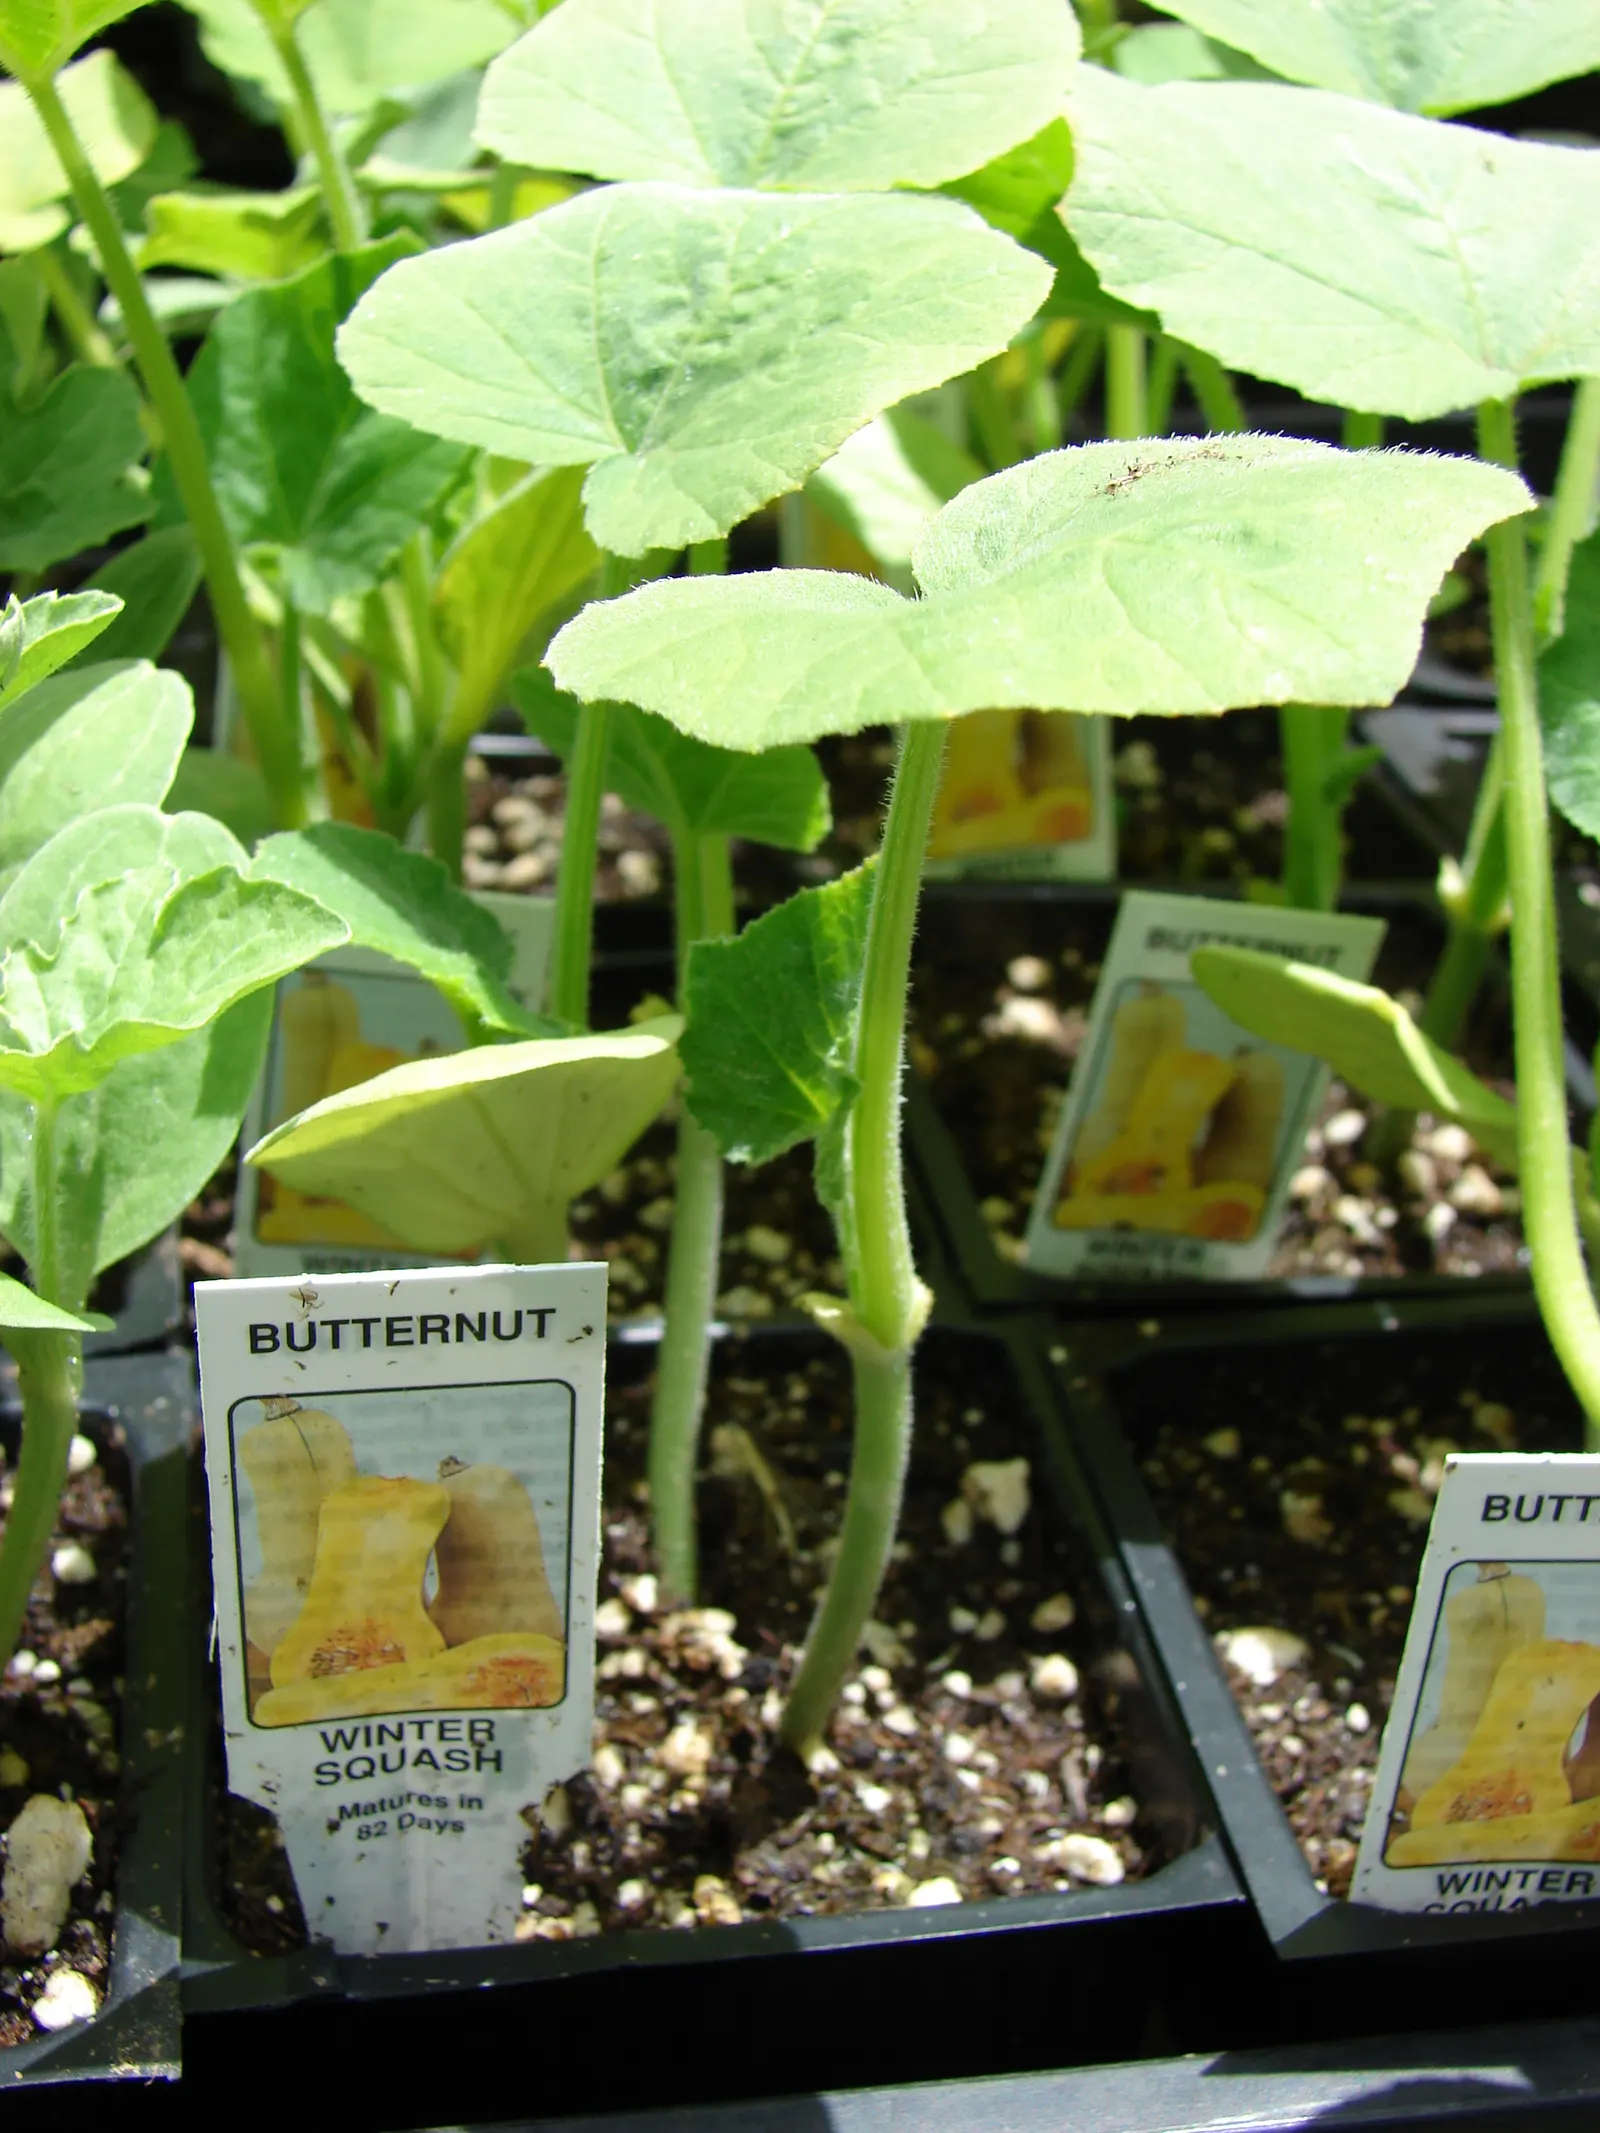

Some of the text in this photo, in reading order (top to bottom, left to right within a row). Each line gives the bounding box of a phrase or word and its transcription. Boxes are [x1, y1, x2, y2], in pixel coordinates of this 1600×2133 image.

[249, 1308, 556, 1354] BUTTERNUT
[320, 1718, 496, 1752] WINTER
[314, 1748, 504, 1786] SQUASH
[338, 1792, 483, 1820] Matures in
[357, 1812, 465, 1840] 82 Days
[1437, 1869, 1596, 1896] WINTER
